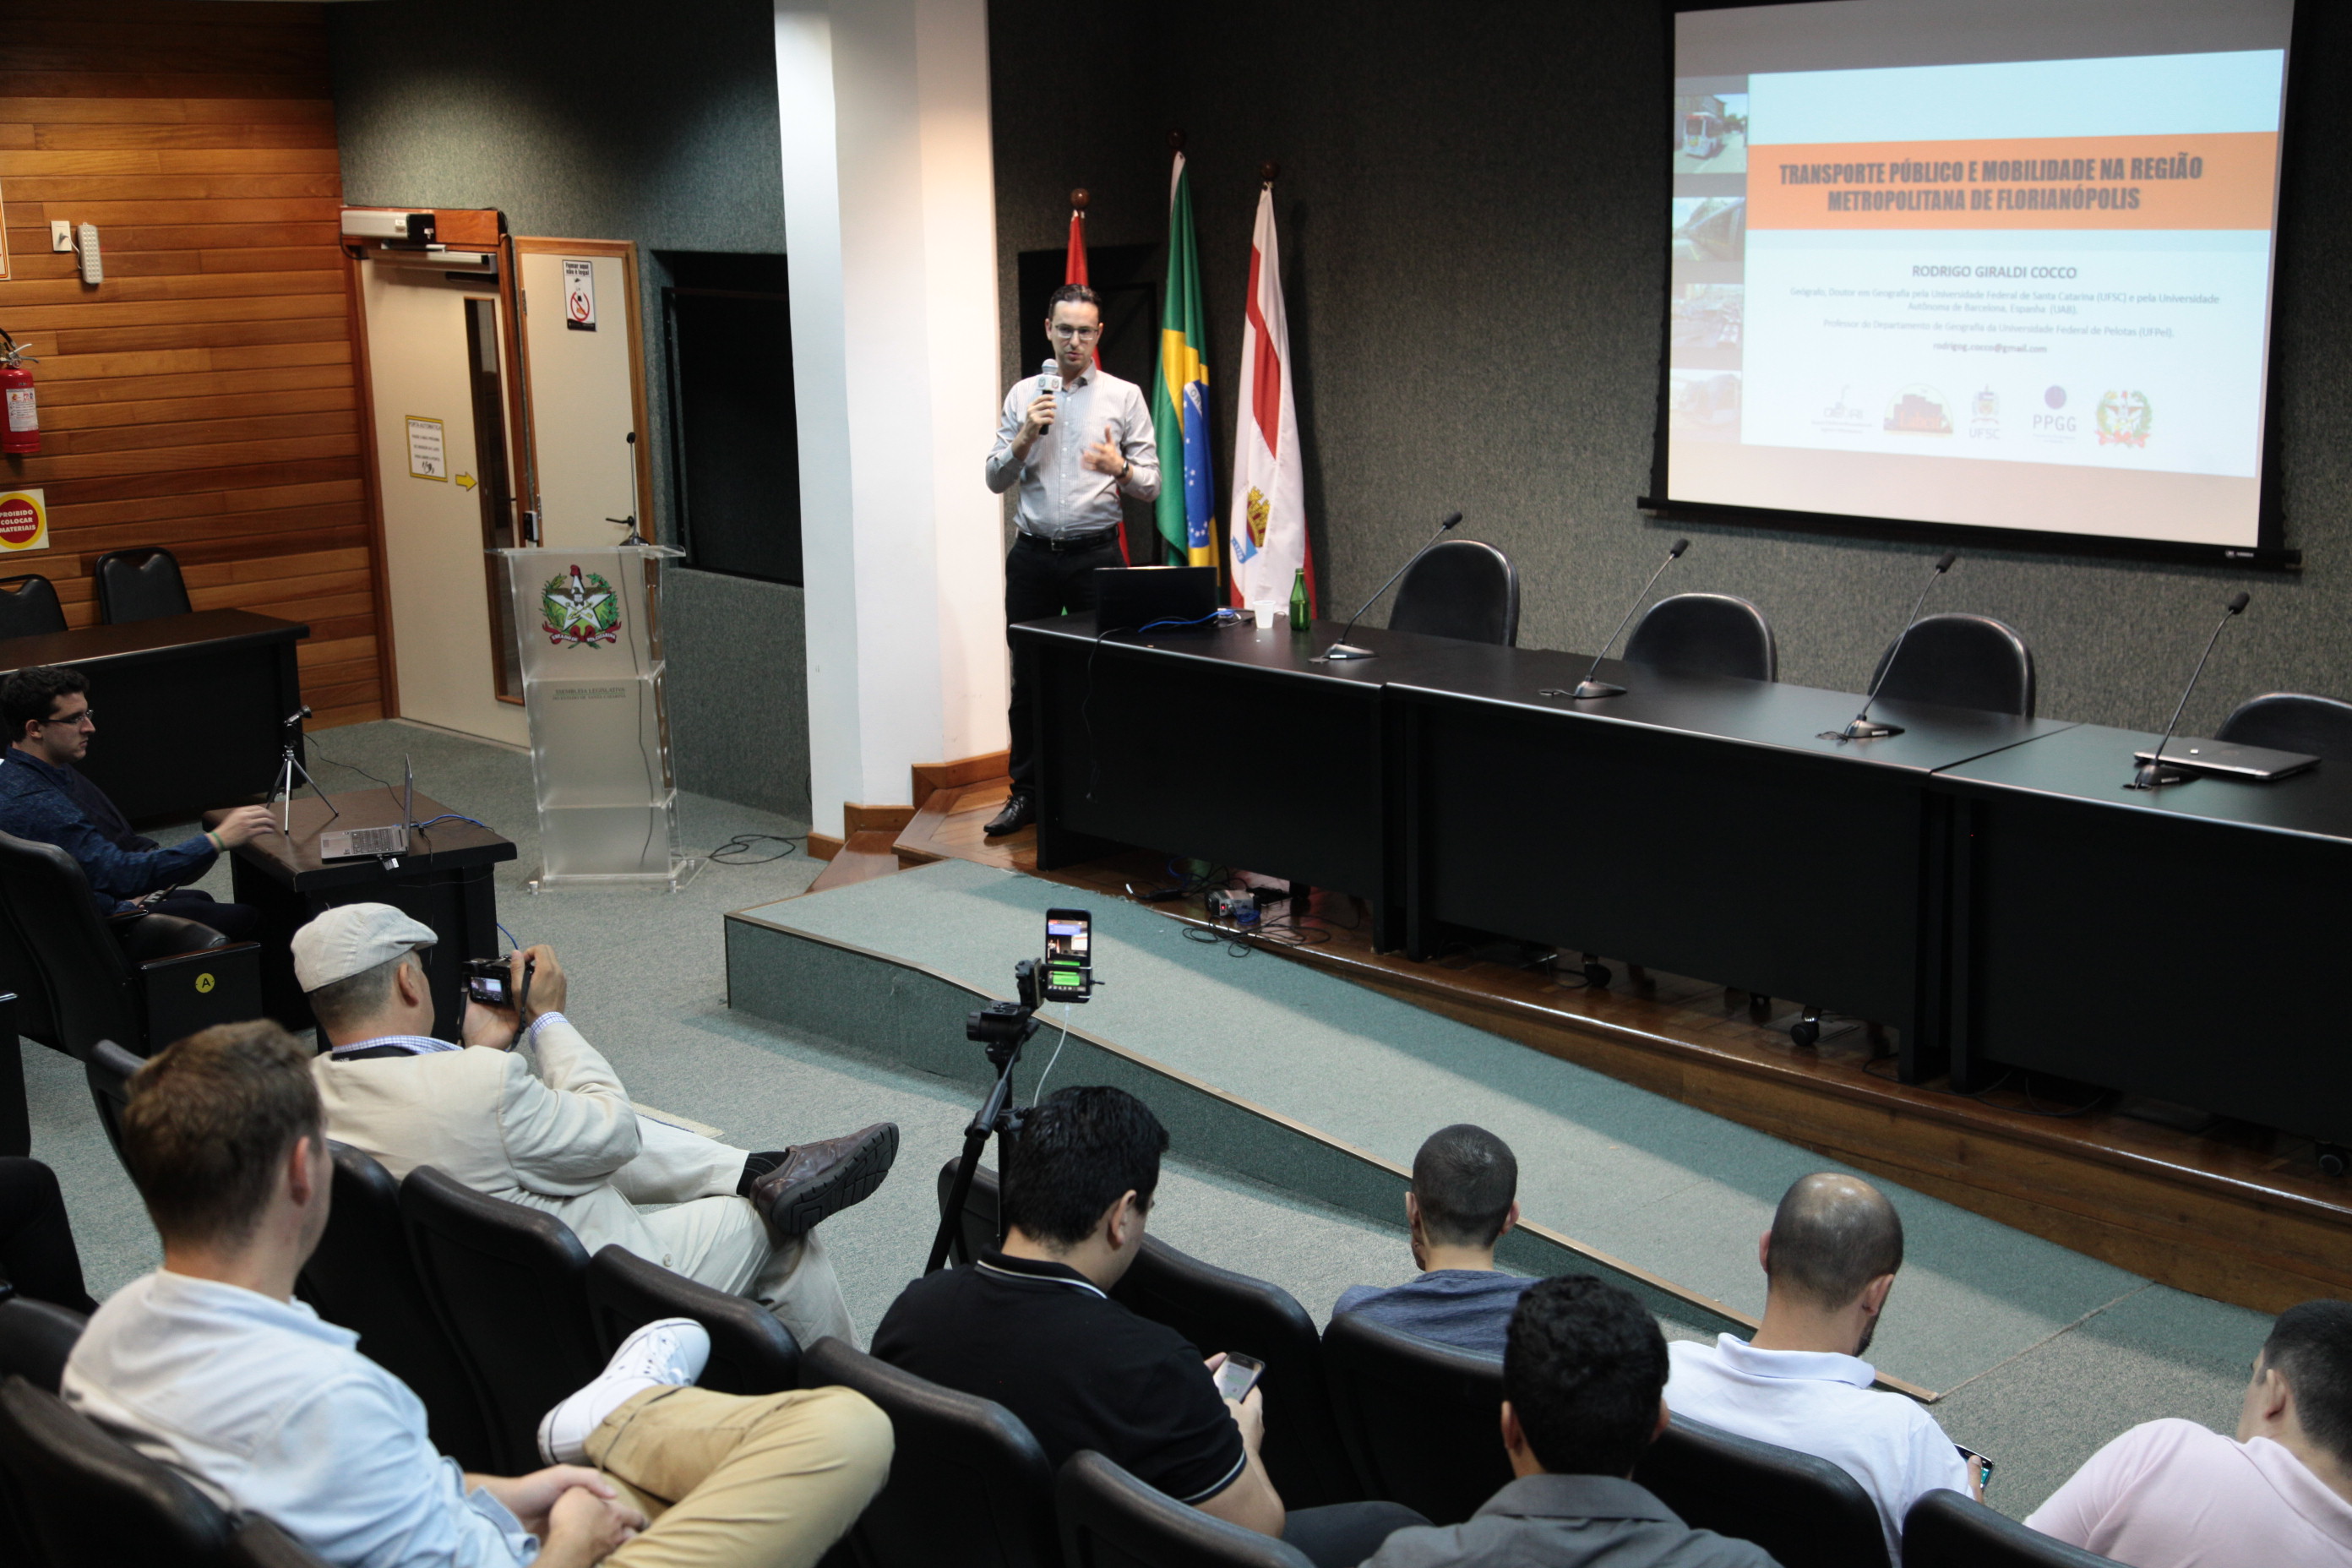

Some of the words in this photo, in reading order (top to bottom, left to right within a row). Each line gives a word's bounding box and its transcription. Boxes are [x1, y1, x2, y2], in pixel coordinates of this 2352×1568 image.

[1779, 163, 1885, 185] TRANSPORTE
[1889, 158, 1964, 183] PÚBLICO
[1968, 161, 1978, 182] E
[1982, 159, 2095, 182] MOBILIDADE
[2099, 158, 2125, 181] NA
[2130, 152, 2203, 180] REGIÃO
[1827, 190, 1966, 211] METROPOLITANA
[1971, 189, 1992, 210] DE
[1996, 184, 2141, 211] FLORIANÓPOLIS
[1913, 265, 1971, 277] RODRIGO
[1975, 265, 2027, 278] GIRALDI
[2030, 267, 2077, 279] COCCO
[1829, 288, 1855, 297] Doutor
[1872, 288, 1910, 299] Geografia
[1913, 289, 1929, 299] pela
[1931, 289, 1984, 299] Universidade
[1986, 290, 2017, 300] Federal
[2019, 291, 2030, 300] de
[2033, 291, 2055, 301] Santa
[2058, 292, 2094, 302] Catarina
[2097, 292, 2127, 303] (UFSC)
[2137, 294, 2157, 304] pela
[2159, 294, 2220, 304] Universidade
[1908, 302, 1950, 312] Autônoma
[1952, 302, 1962, 312] de
[2010, 305, 2045, 315] Espanha
[1823, 319, 1859, 329] Professor
[1861, 320, 1871, 329] do
[1873, 320, 1930, 331] Departamento
[1933, 321, 1943, 330] de
[1945, 321, 1984, 333] Geografia
[1987, 323, 1997, 332] da
[1999, 324, 2054, 334] Universidade
[2056, 324, 2088, 335] Federal
[2090, 325, 2101, 335] de
[2104, 326, 2137, 336] Pelotas
[2033, 414, 2077, 433] PPGG
[1968, 427, 2001, 439] UFSC
[0, 525, 36, 533] MATERIAIS
[202, 977, 211, 988] A
